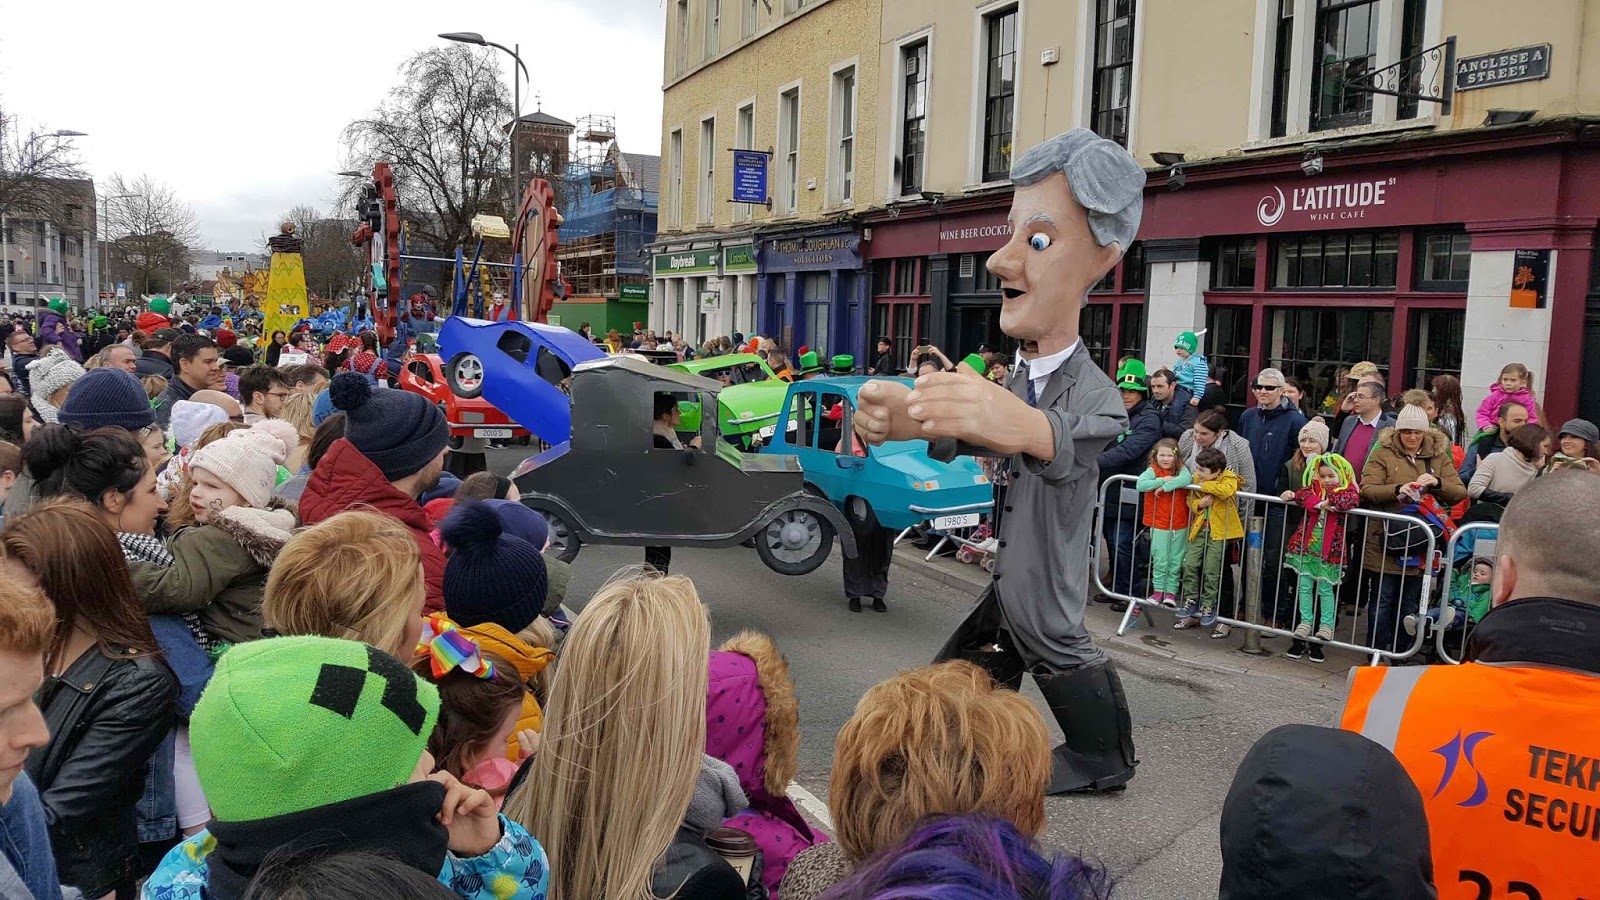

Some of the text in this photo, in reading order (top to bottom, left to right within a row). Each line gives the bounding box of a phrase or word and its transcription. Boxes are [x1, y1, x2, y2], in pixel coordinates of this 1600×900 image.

[1467, 65, 1528, 84] STREET
[1292, 177, 1397, 211] L'ATITUDE 51
[1310, 208, 1365, 221] WINE CAFÉ
[939, 229, 959, 241] WINE
[960, 227, 979, 239] BEER
[780, 241, 804, 254] THOM
[670, 253, 696, 271] Daybreak
[793, 254, 833, 265] SOLICITORS
[482, 429, 503, 437] 2010'S
[944, 515, 968, 527] 1980'S
